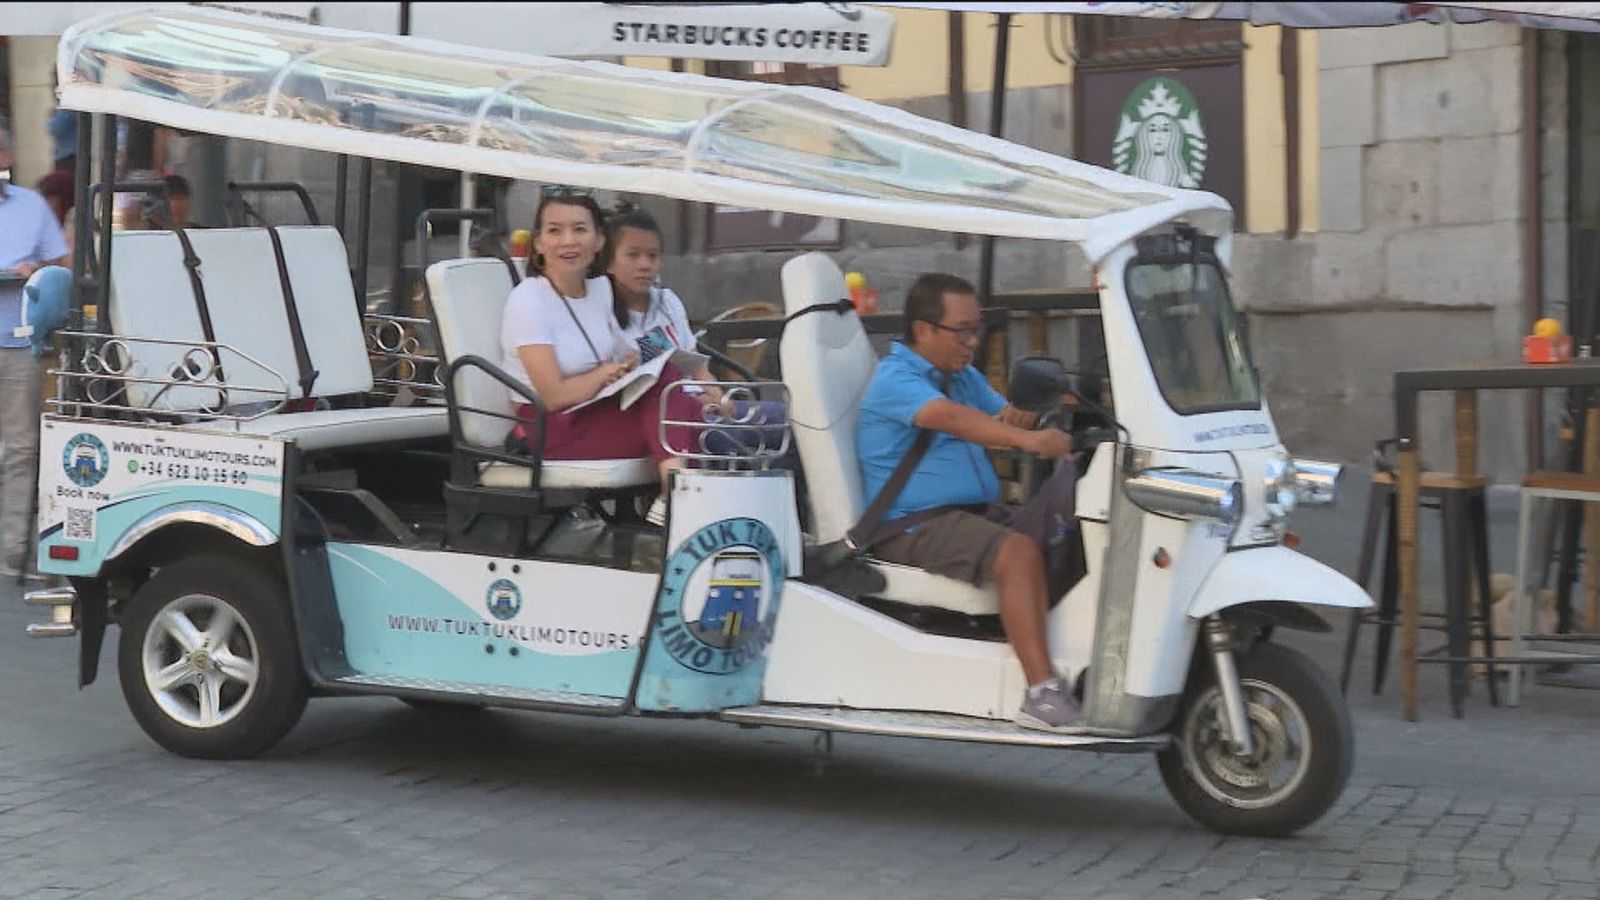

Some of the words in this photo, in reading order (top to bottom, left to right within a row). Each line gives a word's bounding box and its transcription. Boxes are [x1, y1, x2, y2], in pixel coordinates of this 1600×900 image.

[612, 21, 769, 48] STARBUCKS
[774, 29, 870, 53] COFFEE
[141, 461, 162, 476] +34
[194, 466, 210, 482] 10
[56, 485, 83, 499] Book
[87, 491, 111, 502] now
[683, 522, 738, 561] TUK
[656, 610, 713, 668] LIMO
